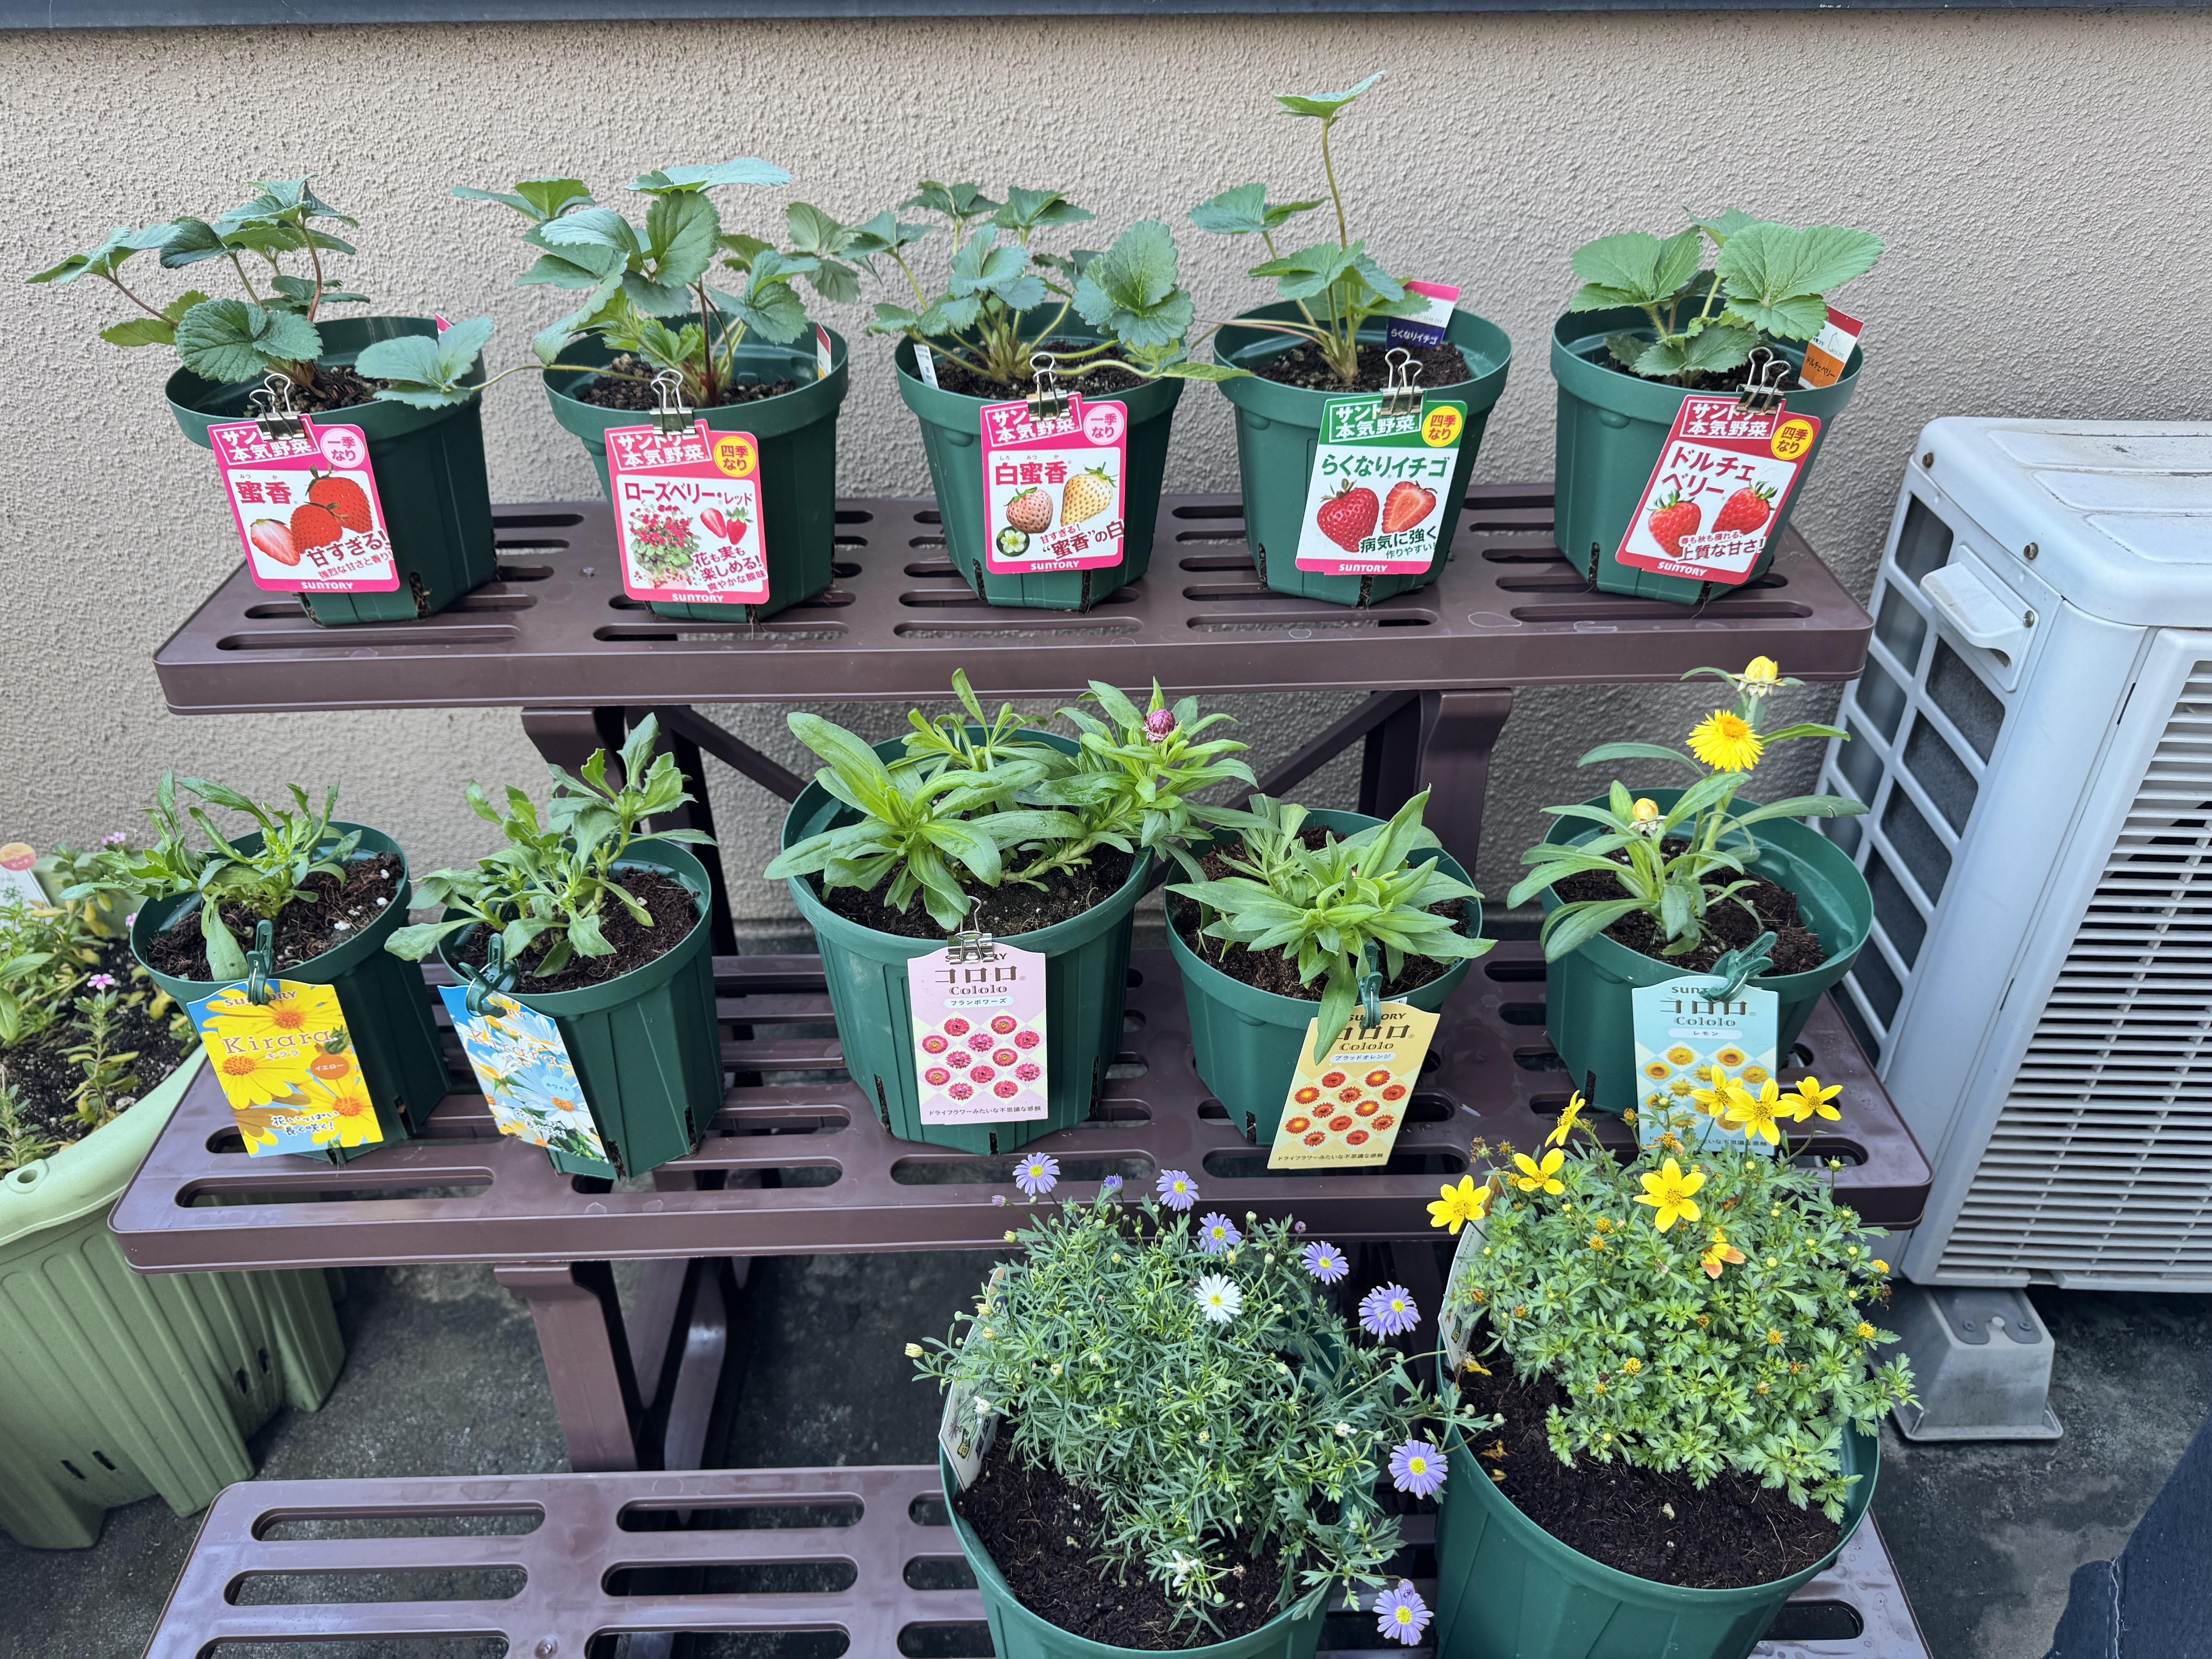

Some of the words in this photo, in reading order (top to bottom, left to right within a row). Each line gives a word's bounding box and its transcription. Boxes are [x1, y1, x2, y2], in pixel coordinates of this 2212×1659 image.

[1091, 413, 1117, 424] 一季
[1430, 415, 1456, 427] 四季
[995, 416, 1075, 443] 本気野菜
[1092, 427, 1114, 439] なり
[1336, 415, 1415, 439] 本気野菜
[1428, 428, 1451, 440] なり
[1687, 419, 1769, 436] 本気野菜
[1780, 427, 1808, 441] 四季
[229, 438, 312, 461] 本気野菜
[328, 436, 356, 449] 一季
[1776, 440, 1800, 454] なり
[331, 450, 356, 461] なり
[622, 444, 704, 467] 本気野菜
[721, 445, 749, 458] 四季
[723, 458, 747, 471] なり
[1321, 453, 1450, 478] らくなりイチゴ
[1670, 447, 1756, 482] ドルチェ
[995, 460, 1067, 486] 白蜜香
[235, 481, 292, 504] 蜜香
[1662, 473, 1724, 497] ベリー
[1360, 526, 1436, 553] 病気に強く
[693, 546, 745, 567] 花も実も
[707, 570, 766, 592] 爽やかな酸味
[935, 966, 1017, 984] コロロ
[949, 985, 1007, 994] Cololo
[225, 991, 297, 1006] SUORY
[1349, 1013, 1407, 1021] SUORY
[1674, 1017, 1736, 1026] Cololo
[222, 1031, 332, 1053] Kirara
[469, 1028, 559, 1066] Kirara
[1340, 1042, 1394, 1051] Cololo
[266, 1050, 298, 1060] キララ
